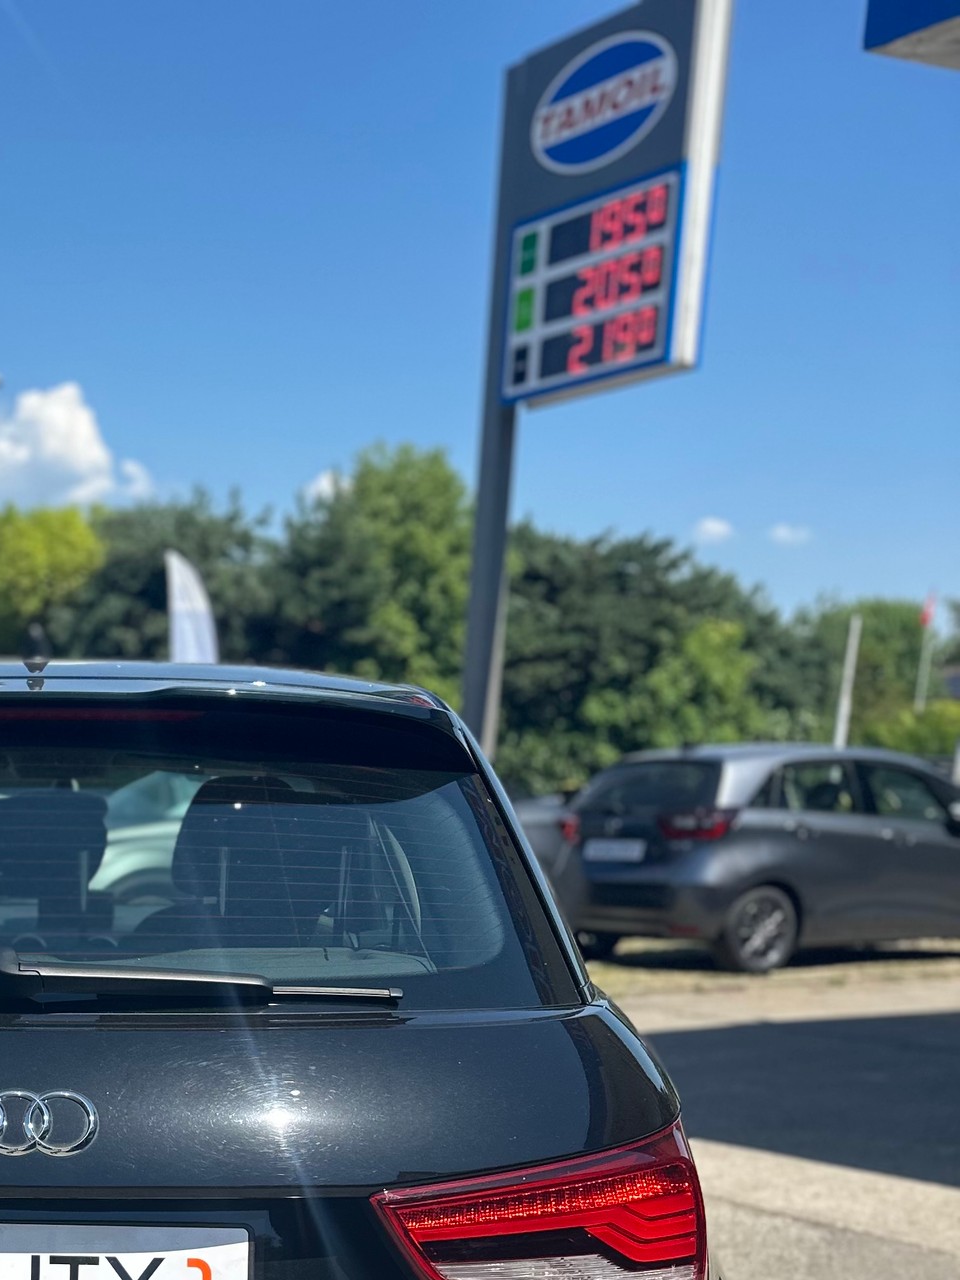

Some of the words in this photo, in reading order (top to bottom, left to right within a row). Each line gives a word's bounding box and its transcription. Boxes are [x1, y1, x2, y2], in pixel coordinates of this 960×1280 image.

[541, 66, 665, 140] TAMOIL
[589, 182, 669, 253] 1950
[571, 245, 662, 318] 2050
